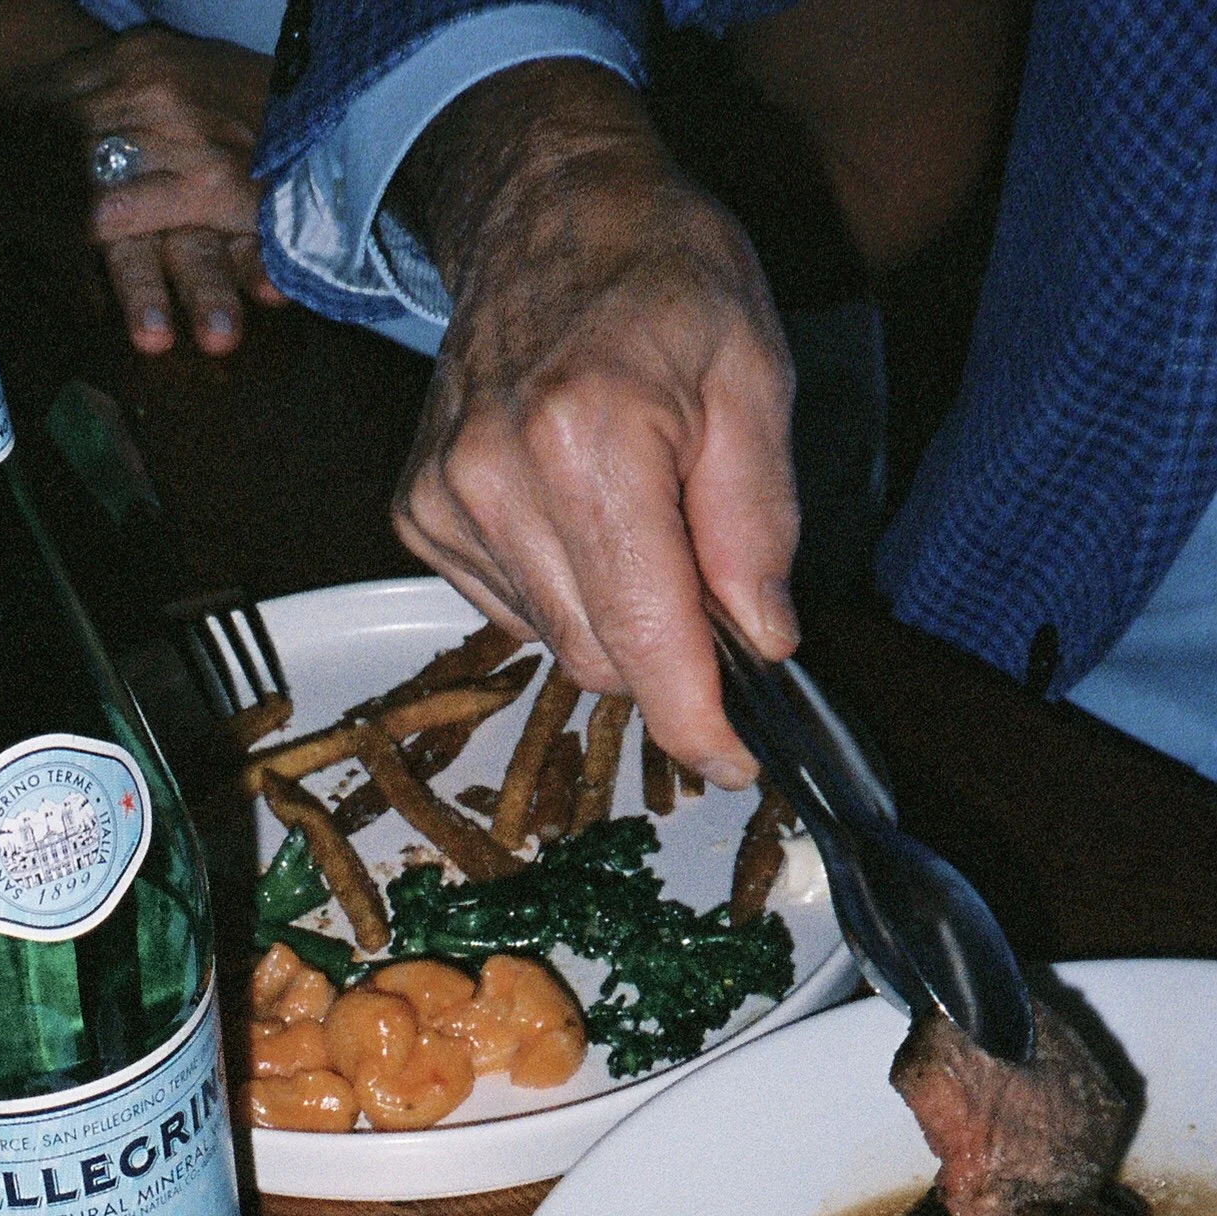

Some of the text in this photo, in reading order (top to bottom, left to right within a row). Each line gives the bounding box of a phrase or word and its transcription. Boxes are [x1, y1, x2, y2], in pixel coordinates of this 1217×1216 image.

[47, 770, 93, 794] TERME
[97, 811, 112, 866] ITALIA
[38, 872, 91, 905] 1899
[42, 1127, 78, 1148] SAN
[84, 1088, 166, 1138] PELLEGRINO
[169, 1058, 200, 1093] TERME
[137, 1140, 210, 1206] MINERAL
[140, 1187, 183, 1216] NATURAL
